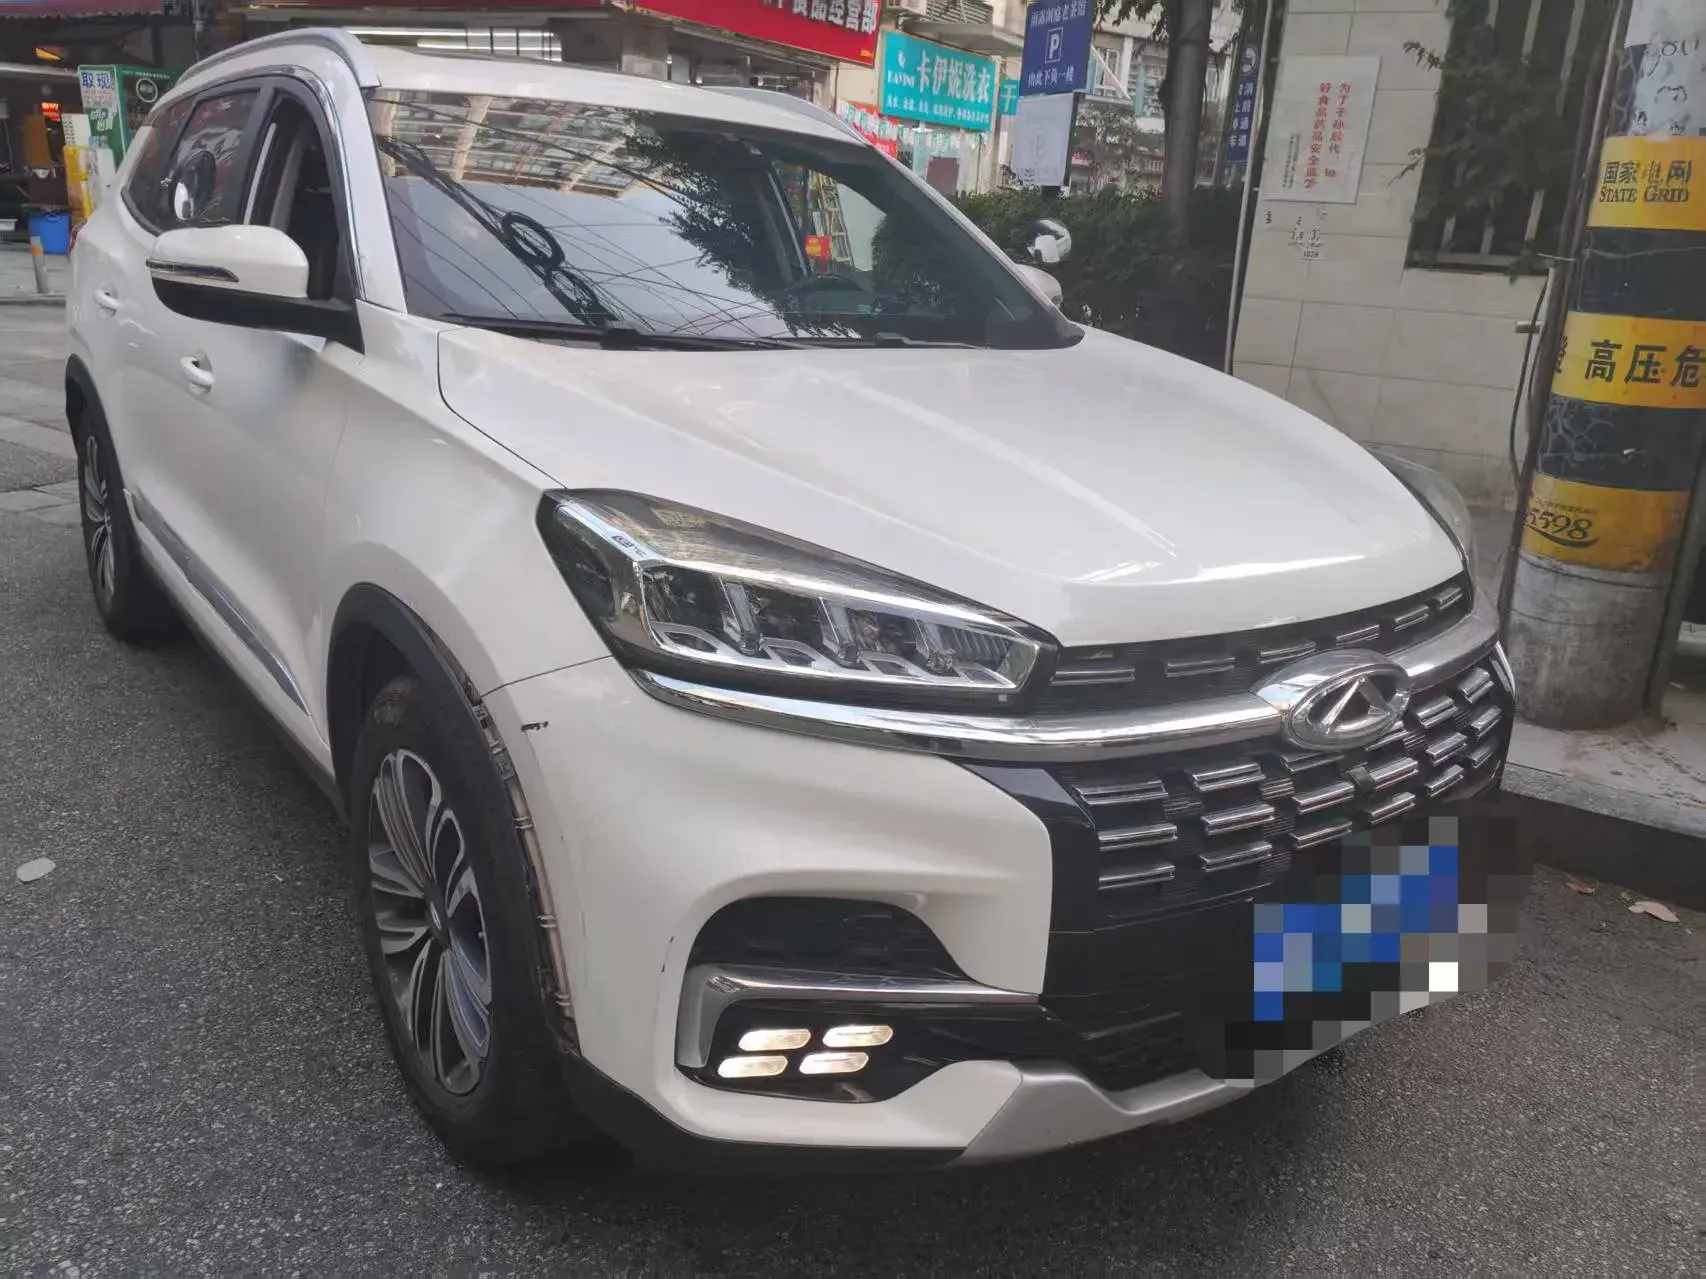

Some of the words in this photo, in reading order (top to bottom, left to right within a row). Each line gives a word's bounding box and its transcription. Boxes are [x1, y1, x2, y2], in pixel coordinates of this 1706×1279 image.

[1048, 33, 1060, 59] P
[1599, 186, 1638, 202] STATE
[1643, 186, 1690, 202] GRID
[1584, 338, 1706, 388] 高压危
